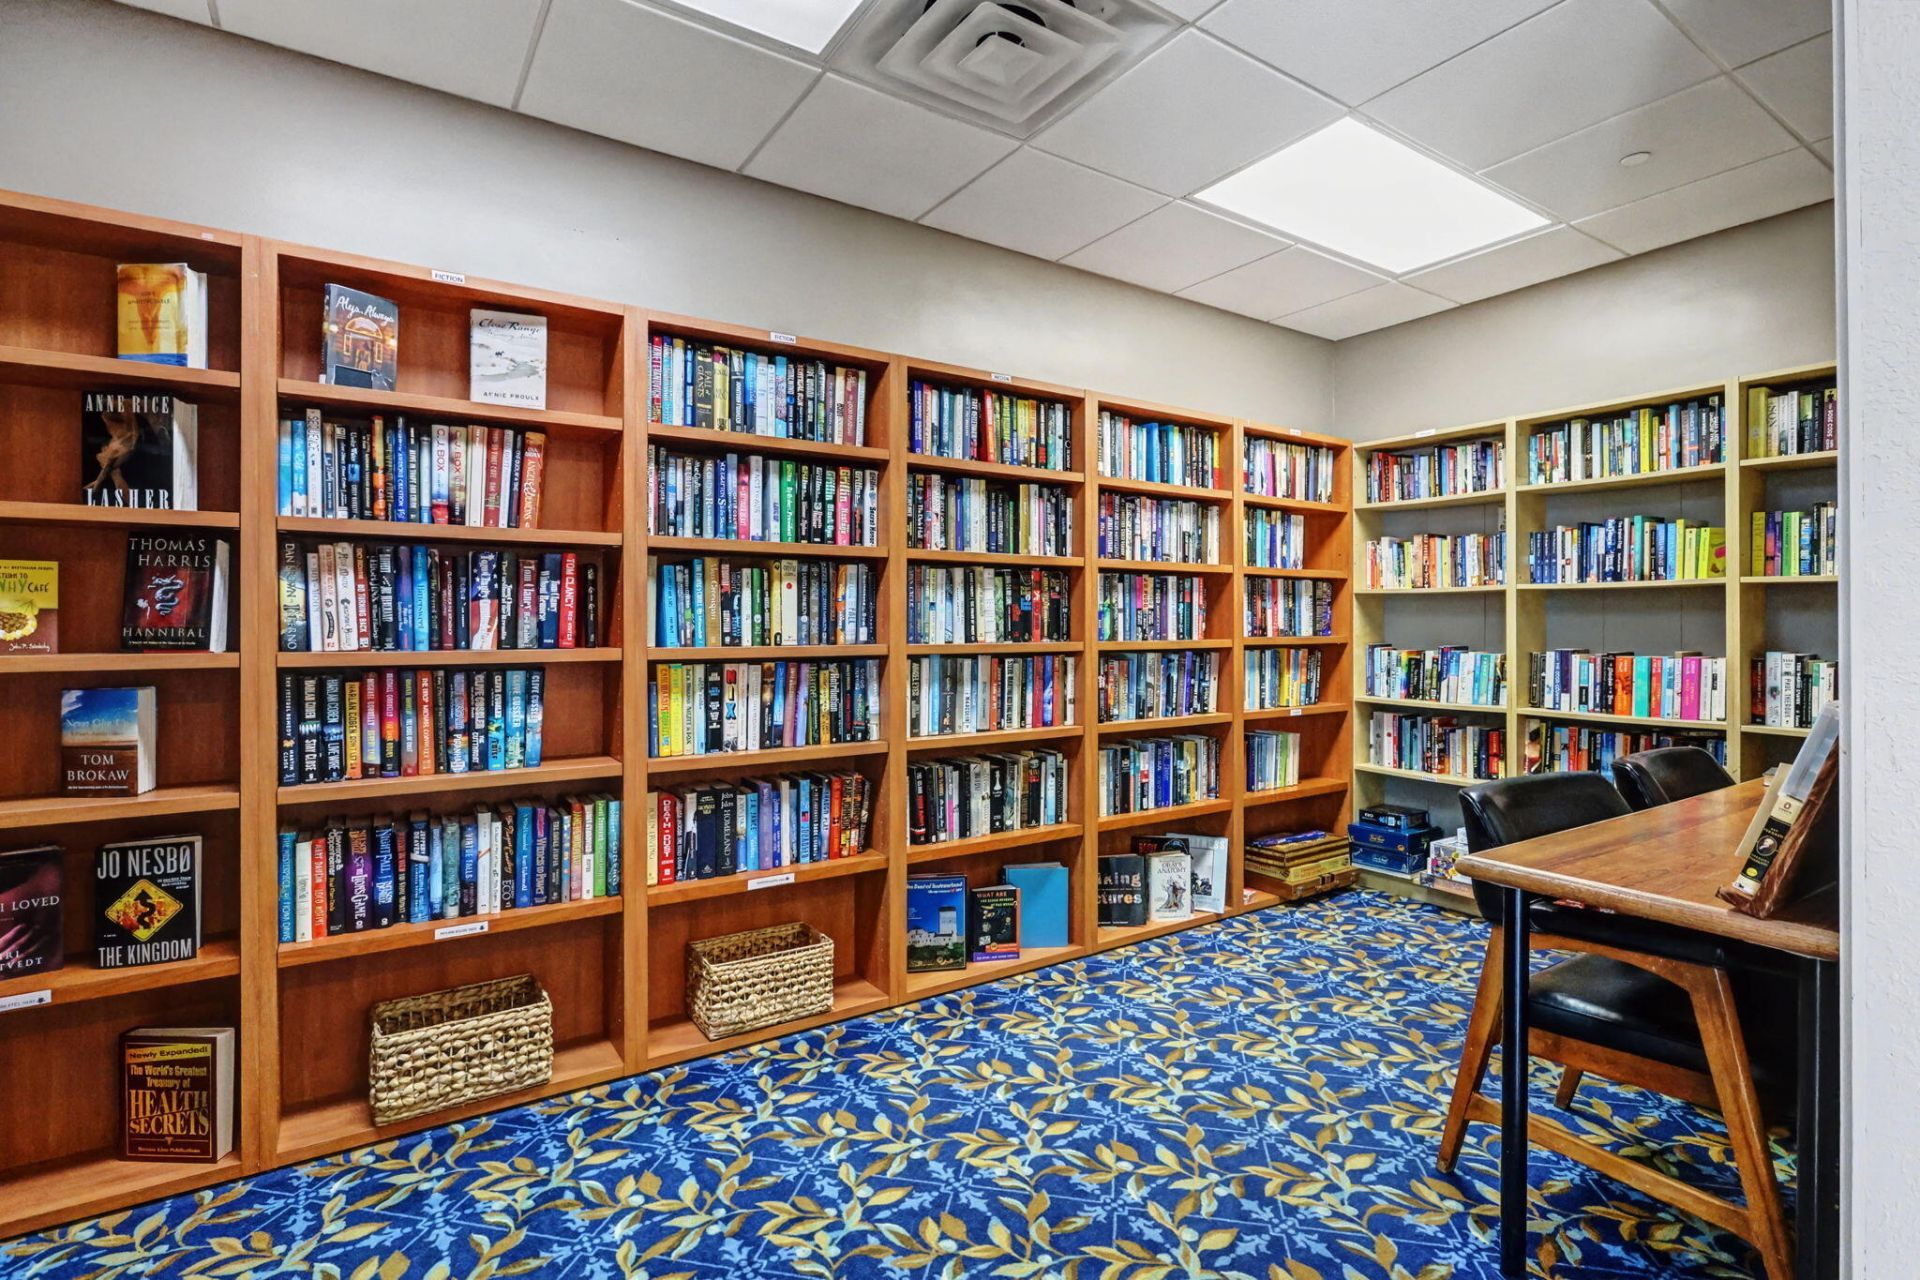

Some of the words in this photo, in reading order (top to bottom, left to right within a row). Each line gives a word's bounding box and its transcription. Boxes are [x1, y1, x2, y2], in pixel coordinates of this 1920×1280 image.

[434, 273, 463, 283] FICTION
[509, 320, 541, 333] Range
[85, 394, 125, 413] ANNE
[132, 396, 169, 414] RICE
[826, 470, 835, 500] Griffin
[839, 470, 850, 502] Griffin
[87, 488, 170, 510] LASHER
[826, 525, 834, 538] Ops
[129, 538, 206, 551] THOMAS
[285, 544, 294, 562] DAN
[138, 554, 211, 567] HARRIS
[566, 559, 575, 574] TOM
[286, 566, 296, 597] BROWN
[524, 565, 534, 582] Tom
[539, 571, 550, 594] Without
[521, 583, 534, 610] Clancy
[564, 577, 573, 608] CLANCY
[709, 581, 717, 619] Greenspan
[123, 627, 204, 637] HANNIBAL
[283, 604, 300, 649] INFERNO
[304, 680, 316, 701] HARLAN
[327, 679, 338, 702] HARLAN
[367, 678, 375, 699] MICHAEL
[475, 675, 484, 696] CLIVE
[494, 675, 502, 692] CLIVE
[512, 674, 520, 694] CLIVE
[531, 675, 539, 693] CLIVE
[830, 674, 839, 712] Retribution
[348, 684, 357, 710] HARLAN
[494, 694, 502, 718] CUSSLER
[305, 702, 316, 719] COBEN
[328, 703, 339, 723] COBEN
[475, 697, 484, 729] CUSSLER
[512, 696, 521, 728] CUSSLER
[531, 694, 539, 724] CUSSLER
[348, 713, 357, 734] COBEN
[305, 739, 316, 752] STAY
[328, 743, 339, 754] LIVE
[453, 734, 462, 762] PIRANHA
[81, 754, 114, 766] TOM
[305, 754, 317, 771] CLOSE
[329, 755, 339, 770] WIRE
[67, 770, 129, 781] BROKAW
[335, 831, 343, 863] Lawrence
[377, 829, 392, 853] NIGHT
[465, 833, 473, 858] VIRTUE
[97, 850, 120, 880] JO
[128, 845, 191, 878] NESBØ
[328, 831, 336, 876] Oppenheimer
[376, 854, 392, 873] FALL
[351, 874, 367, 894] LION'S
[502, 880, 511, 900] ECO
[11, 896, 60, 912] LOVED
[282, 902, 291, 921] FIONA
[351, 894, 368, 919] GAME
[282, 922, 291, 941] DAVIS
[98, 946, 123, 968] THE
[127, 938, 192, 965] KINGDOM
[129, 1051, 157, 1060] Newly
[160, 1047, 208, 1056] Expanded!
[131, 1065, 143, 1075] The
[145, 1065, 173, 1075] World's
[175, 1066, 207, 1076] Greatest
[147, 1077, 179, 1088] Treasury
[129, 1090, 208, 1119] HEALTH
[129, 1109, 209, 1135] SECRETS
